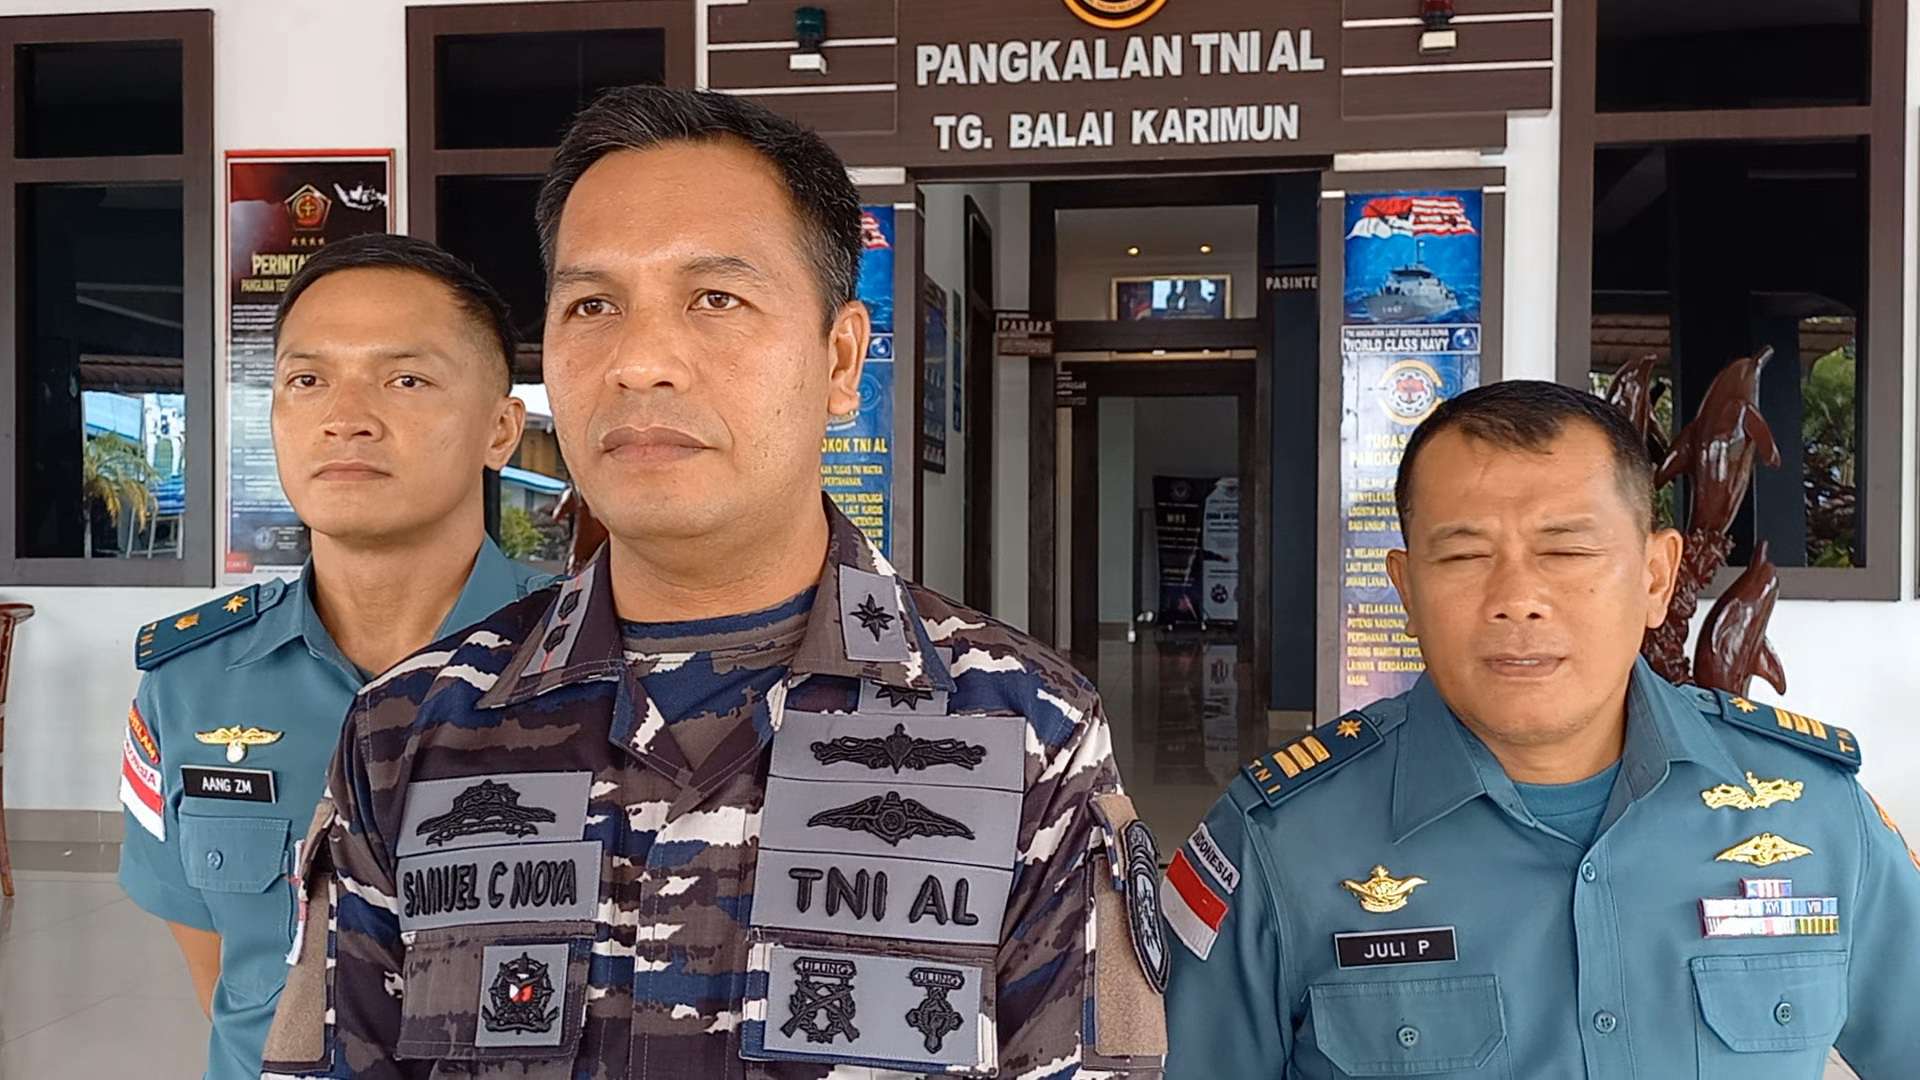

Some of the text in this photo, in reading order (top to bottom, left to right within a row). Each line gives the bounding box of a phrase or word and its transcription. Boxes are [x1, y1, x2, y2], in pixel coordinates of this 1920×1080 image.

[916, 29, 1325, 86] PANGKALAN TNI AL
[932, 104, 1299, 151] TG. BALAI KARIMUN
[252, 253, 311, 275] PERINTA
[1344, 336, 1450, 352] WORLD CLASS NAVY
[852, 437, 871, 452] TNI
[873, 437, 888, 452] AL
[201, 776, 252, 794] AANG ZM
[403, 858, 577, 918] SAMUEL C NOYA
[788, 866, 979, 926] TNI AL
[1364, 939, 1430, 959] JULI P
